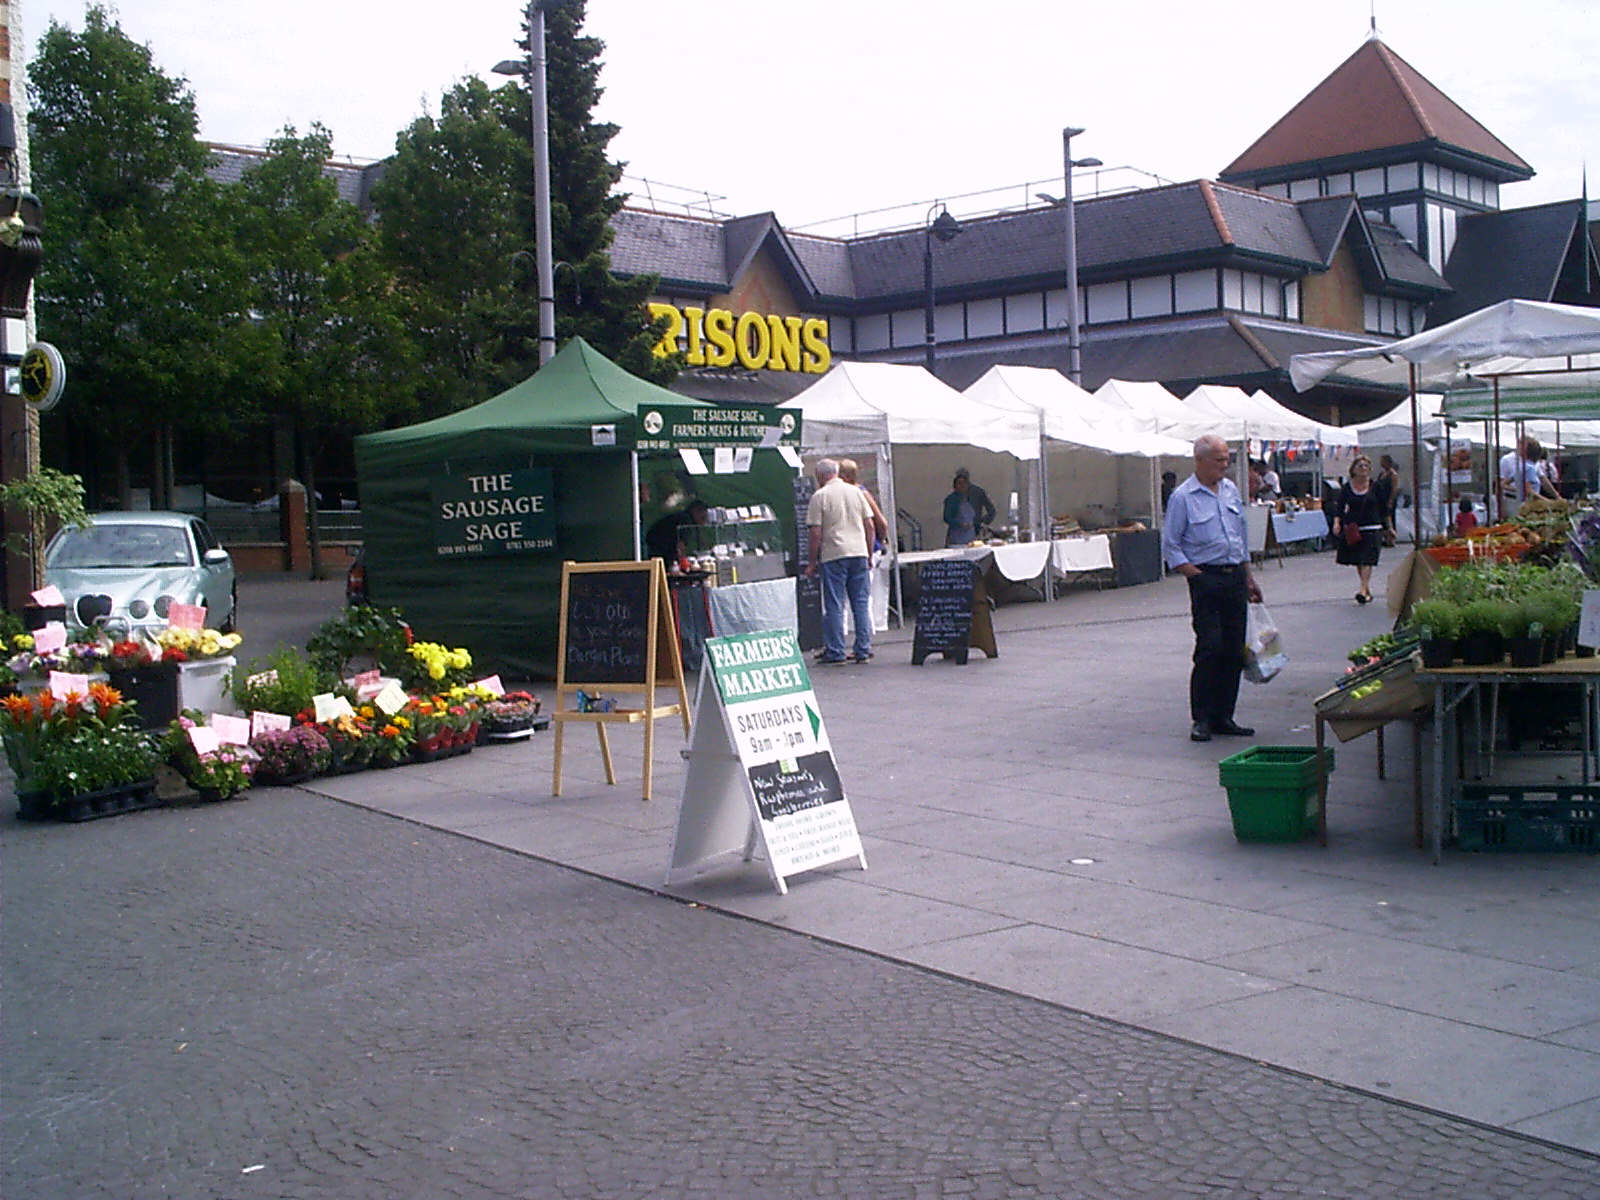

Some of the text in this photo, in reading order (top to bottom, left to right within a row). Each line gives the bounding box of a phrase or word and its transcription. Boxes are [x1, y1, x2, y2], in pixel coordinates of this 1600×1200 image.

[693, 408, 707, 421] THE
[708, 409, 740, 422] SAUSAGE
[741, 410, 759, 422] SAGE
[672, 424, 707, 436] FARMERS
[708, 424, 732, 437] MEATS
[468, 474, 513, 493] THE
[441, 495, 544, 519] SAUSAGE
[466, 521, 523, 541] SAGE
[723, 663, 803, 697] MARKET
[737, 705, 803, 733] SATURDAYS
[750, 736, 773, 753] 9am
